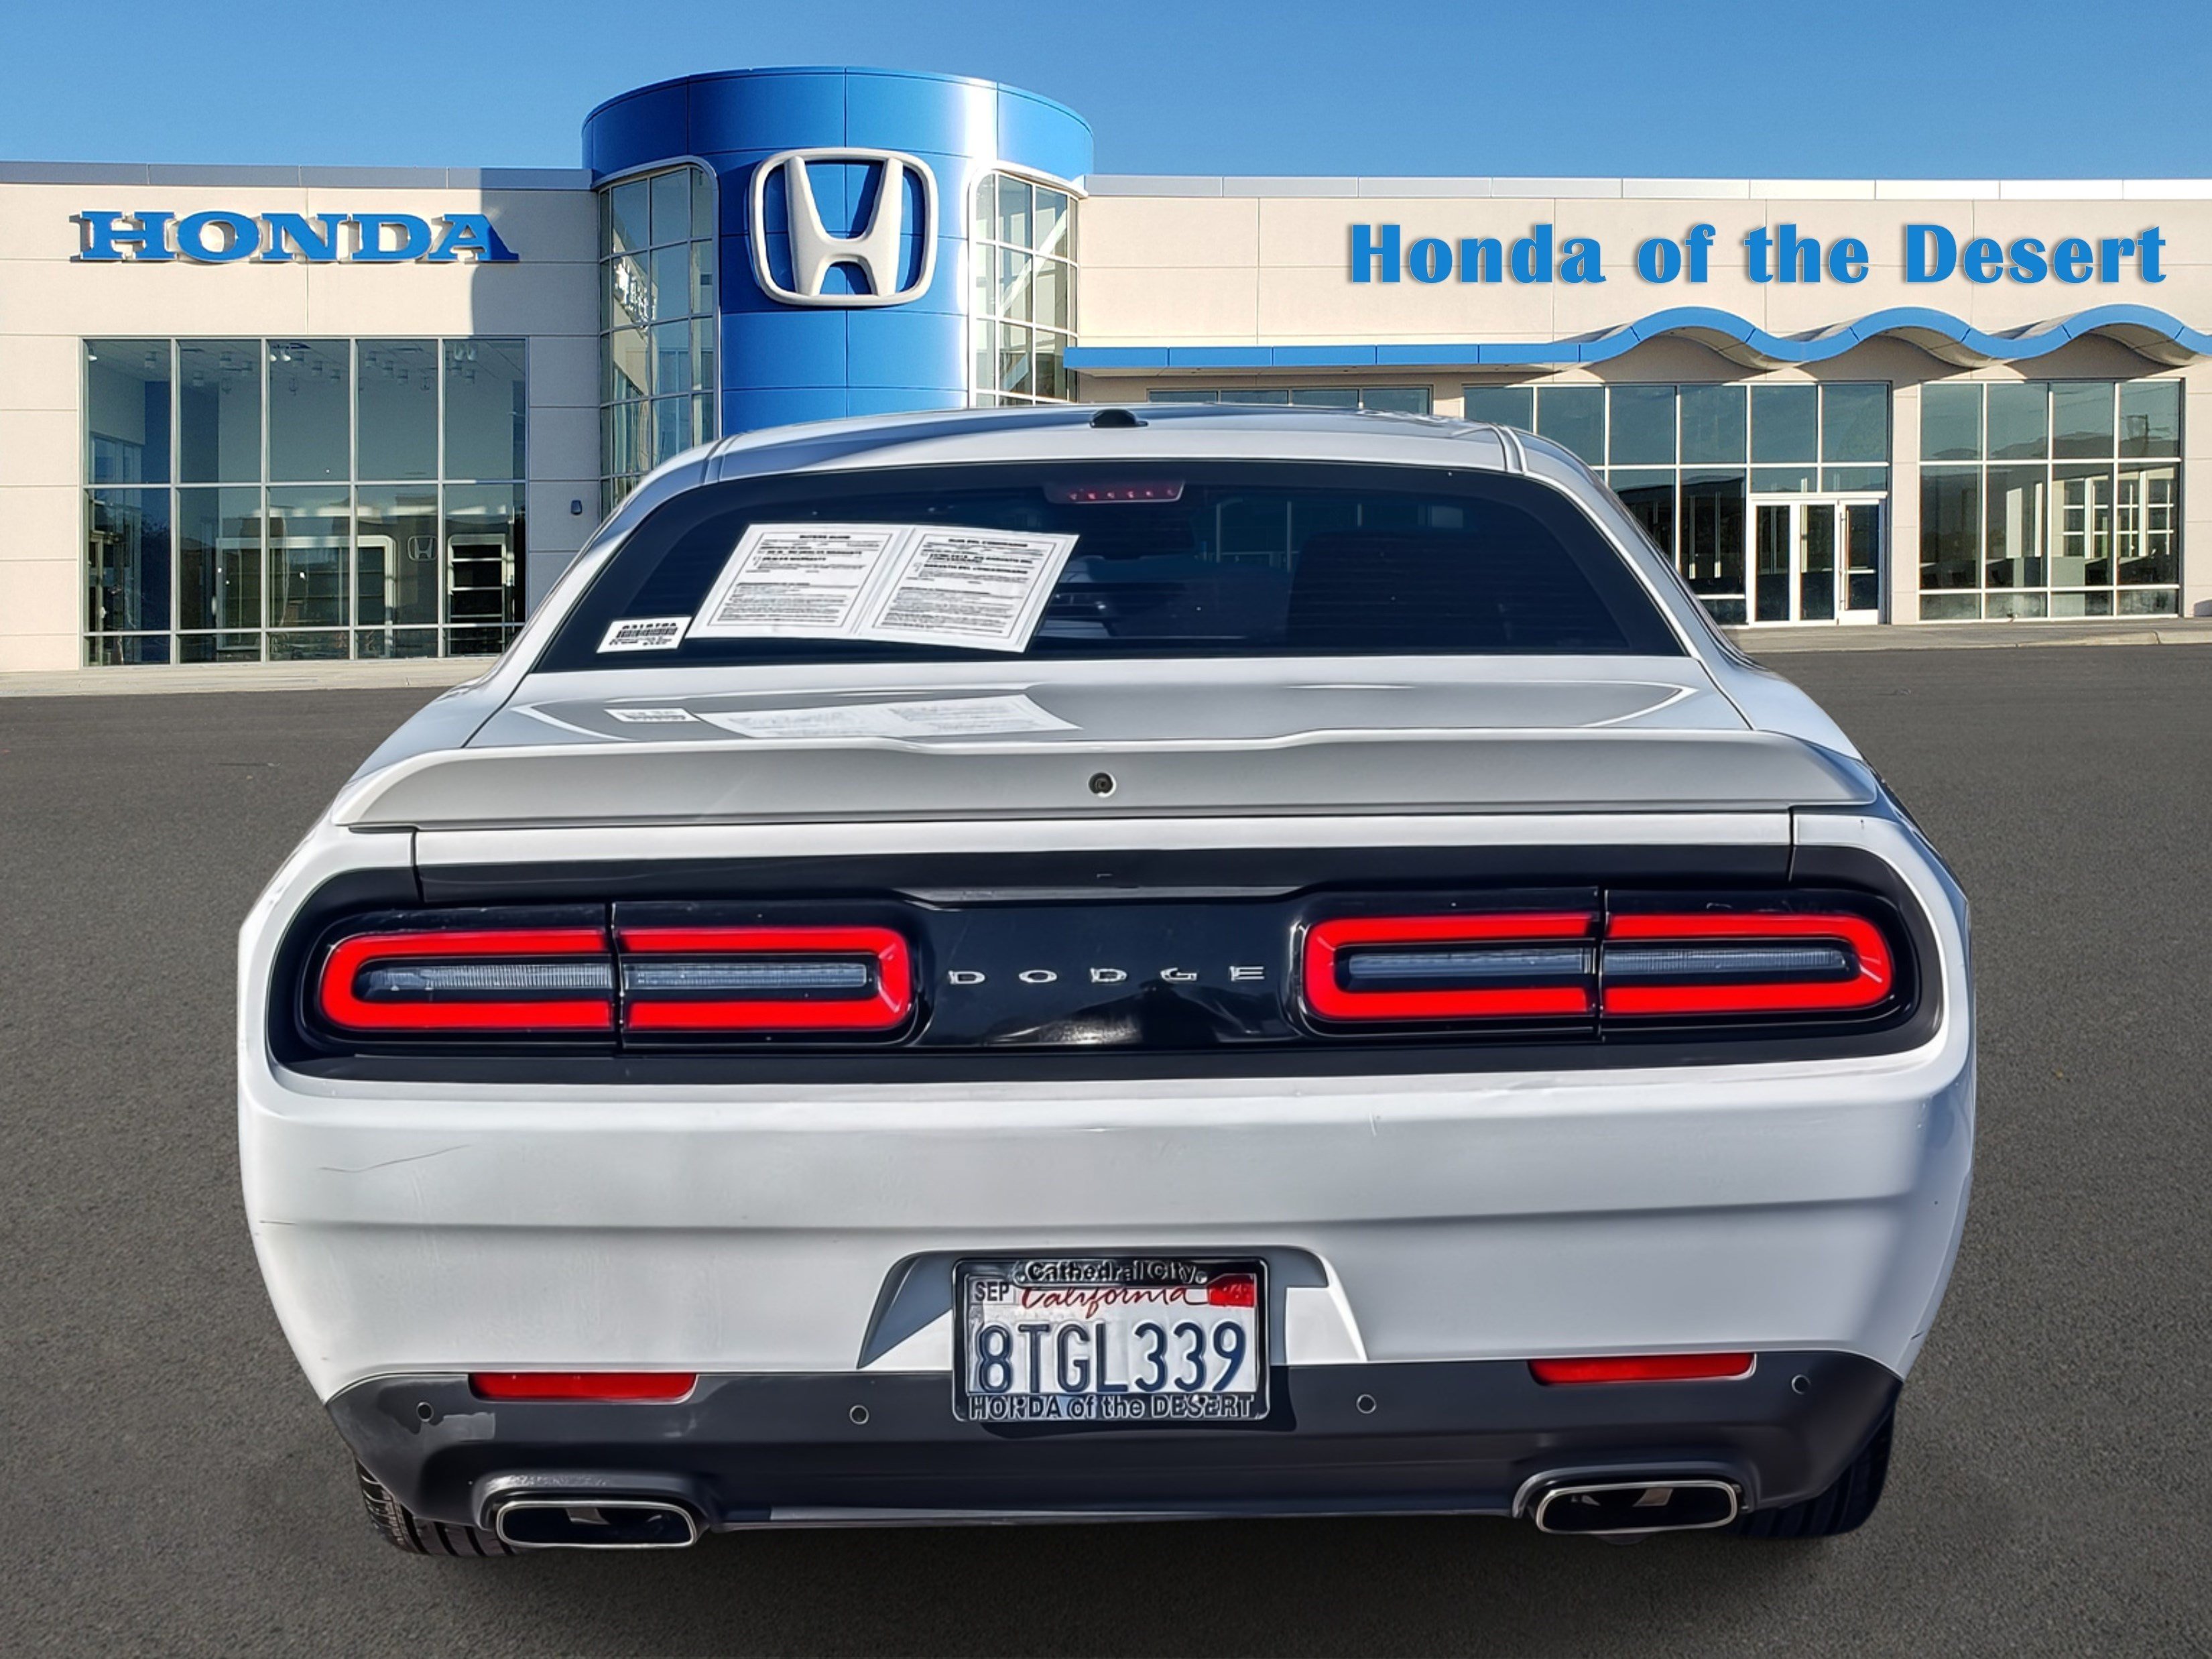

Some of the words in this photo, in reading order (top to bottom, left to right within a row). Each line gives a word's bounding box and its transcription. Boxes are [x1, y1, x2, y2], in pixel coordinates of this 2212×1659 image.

[81, 210, 519, 262] HONDA
[1351, 223, 1607, 284] Honda
[1638, 223, 1716, 284] of
[1744, 223, 1869, 284] the
[1906, 224, 2167, 284] Desert
[947, 965, 1267, 985] DODGE
[1024, 1262, 1144, 1282] Cathedral
[974, 1281, 1010, 1302] SEP
[1021, 1286, 1209, 1318] California
[979, 1321, 1247, 1394] 8TGL339
[969, 1395, 1060, 1419] HONDA
[1068, 1395, 1097, 1418] of
[1101, 1395, 1145, 1418] the
[1152, 1396, 1255, 1418] DESERT
